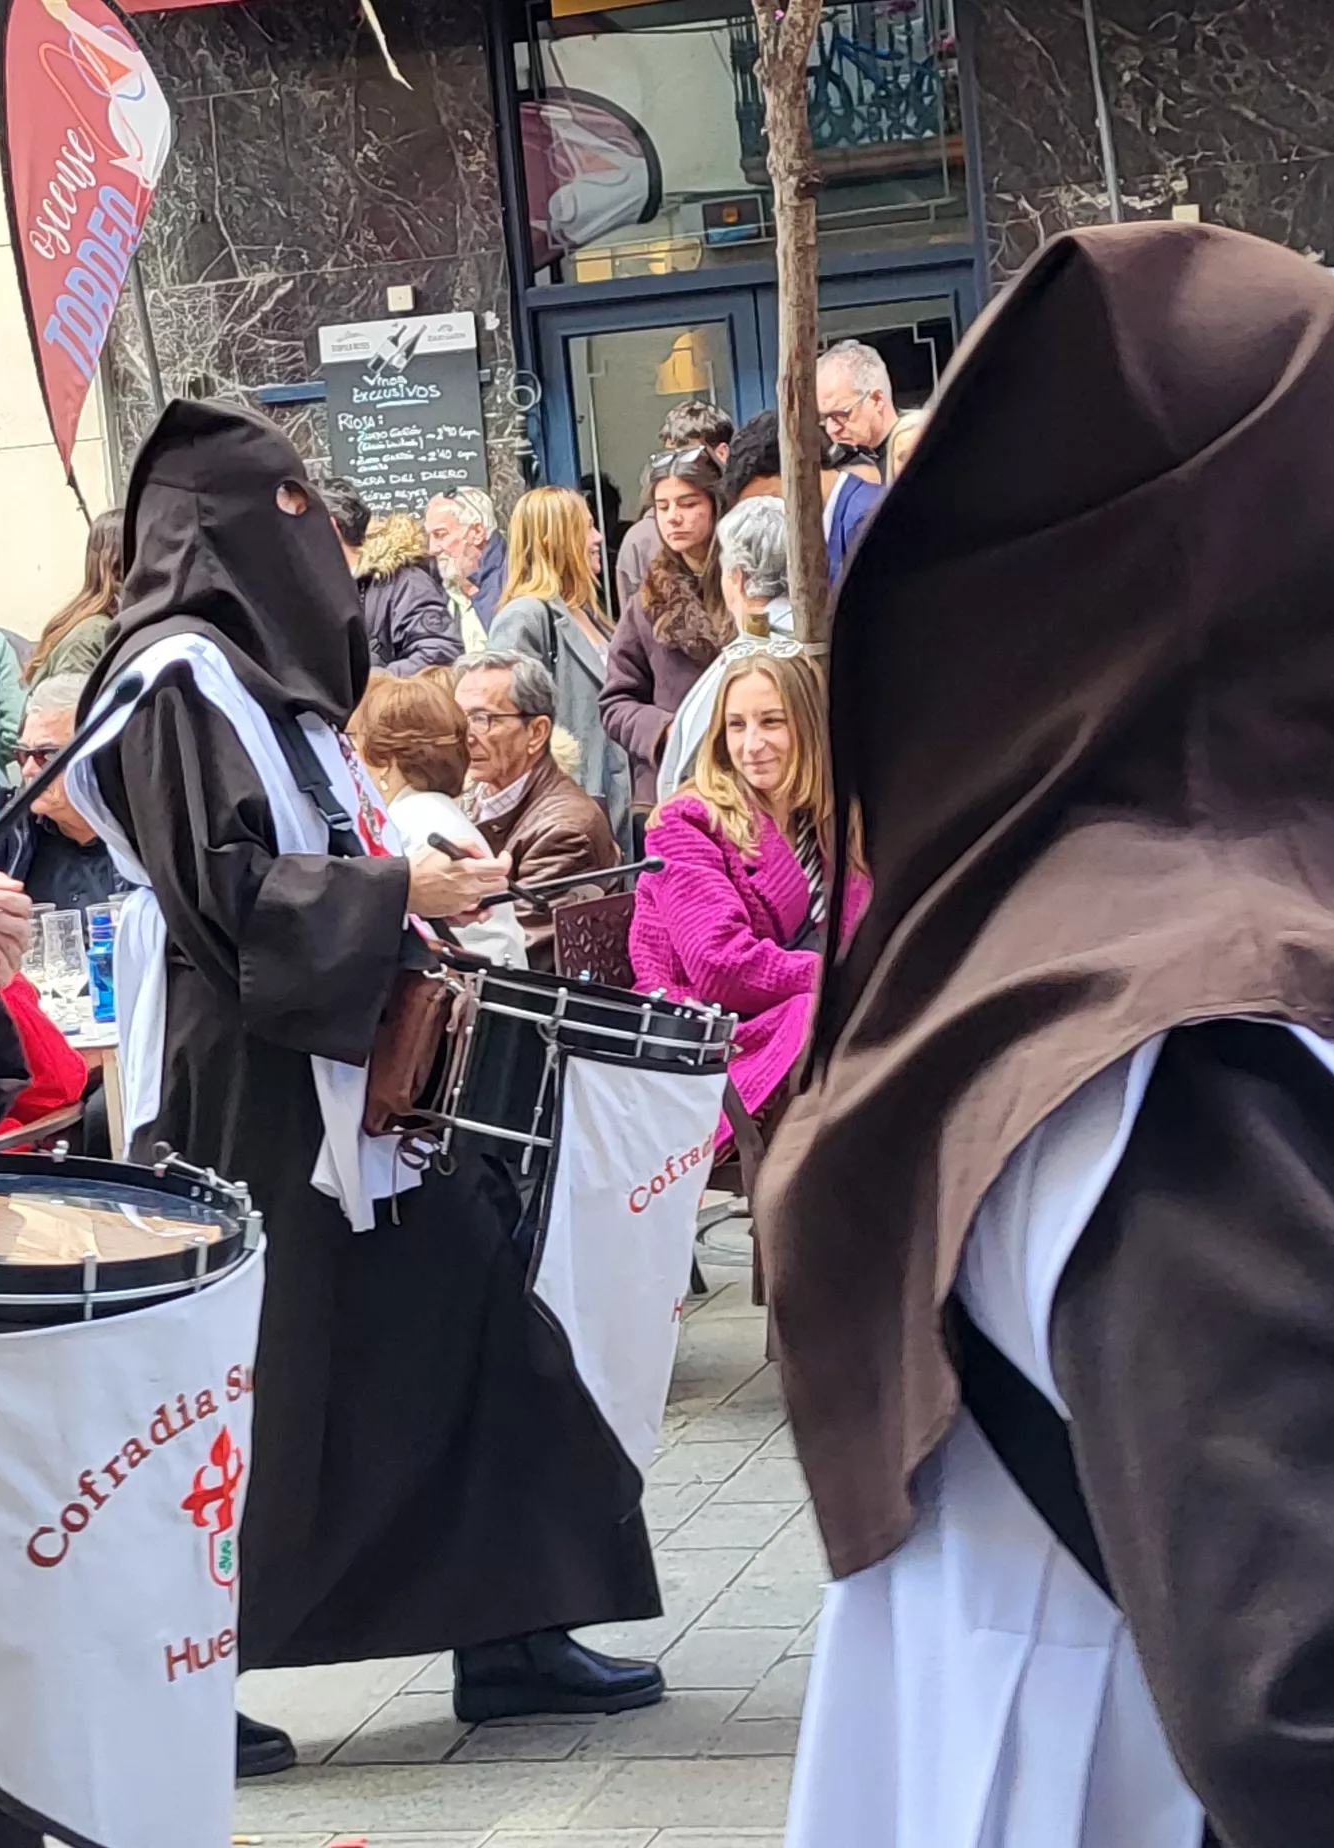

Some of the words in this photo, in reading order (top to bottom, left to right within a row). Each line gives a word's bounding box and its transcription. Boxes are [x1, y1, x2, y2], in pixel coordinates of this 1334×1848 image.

[29, 127, 96, 260] oscense
[389, 473, 416, 484] DEL
[419, 469, 468, 481] DUERO
[26, 1388, 219, 1568] Cofradia
